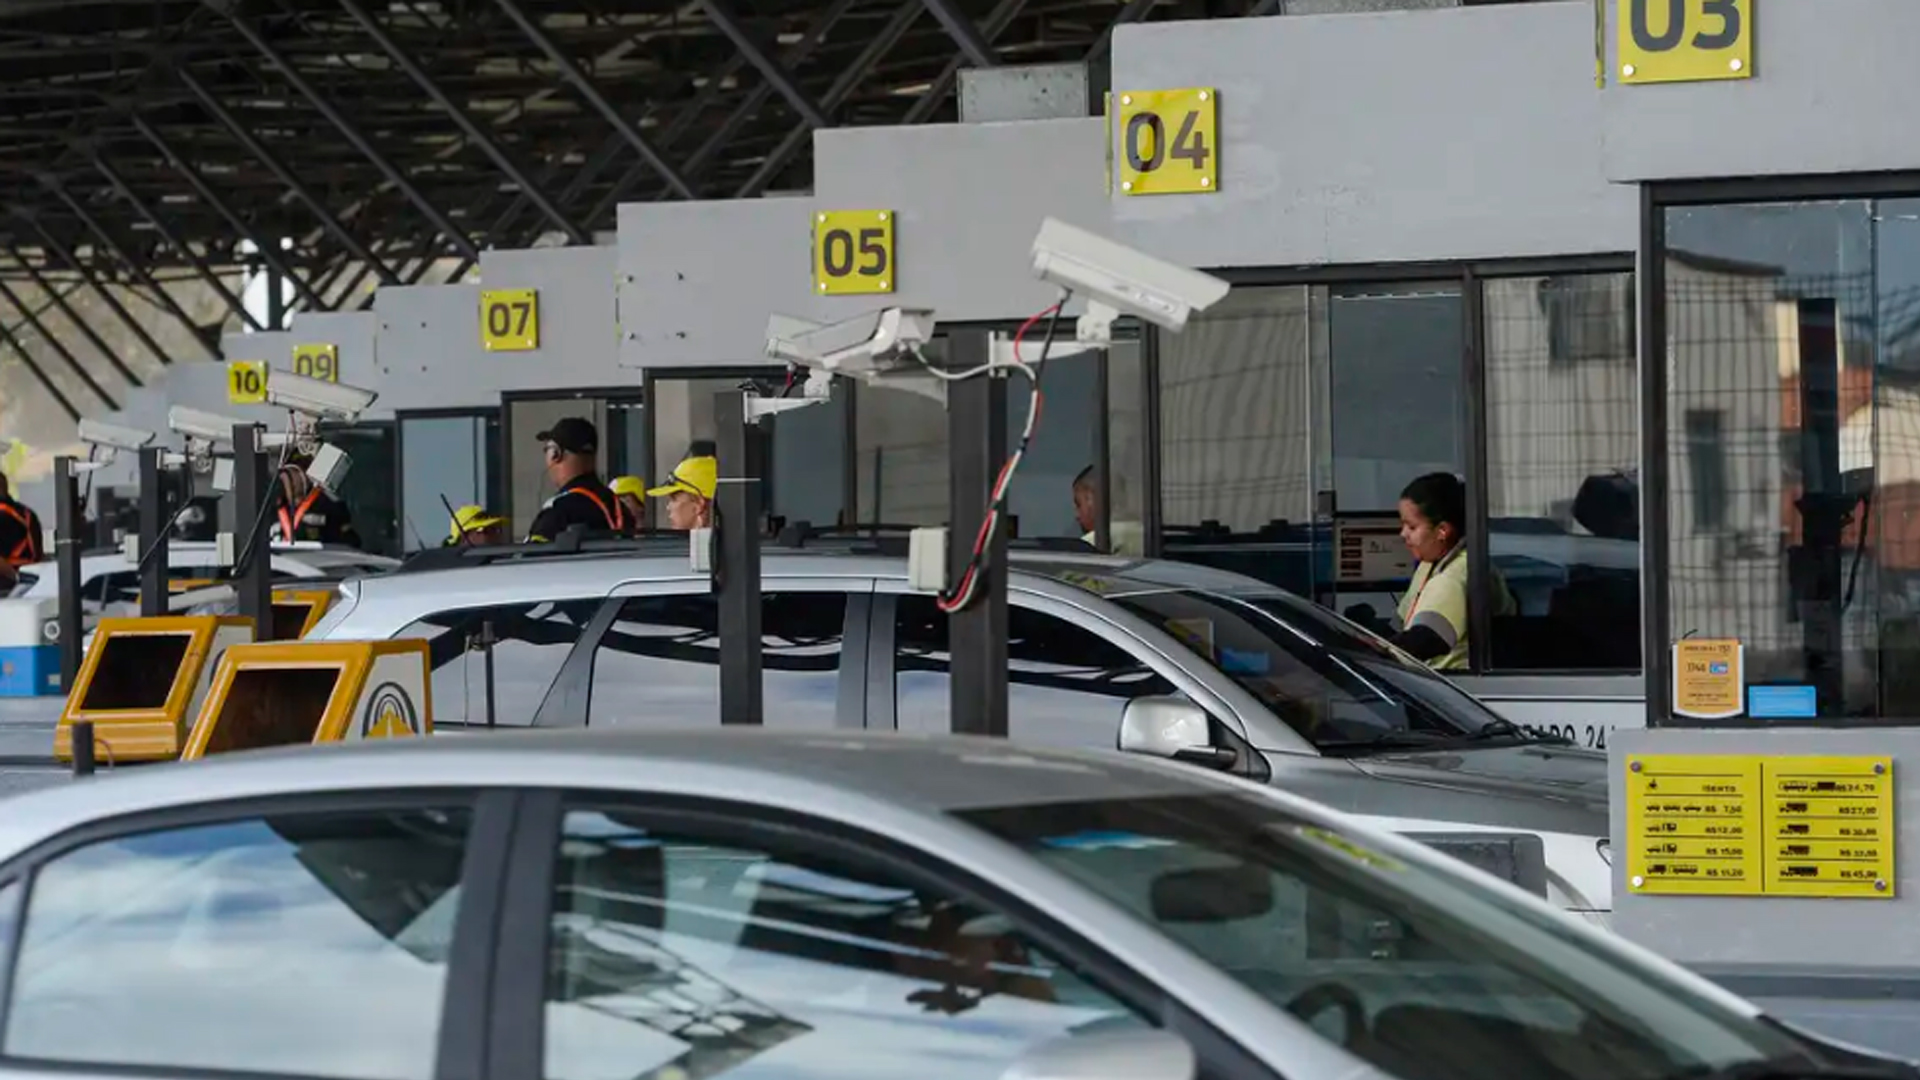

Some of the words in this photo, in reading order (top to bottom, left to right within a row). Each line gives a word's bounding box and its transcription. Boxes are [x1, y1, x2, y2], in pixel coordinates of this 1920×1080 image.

[1631, 0, 1741, 52] 03
[1125, 111, 1209, 172] 04
[823, 229, 887, 277] 05
[488, 302, 530, 338] 07
[234, 369, 260, 394] 10
